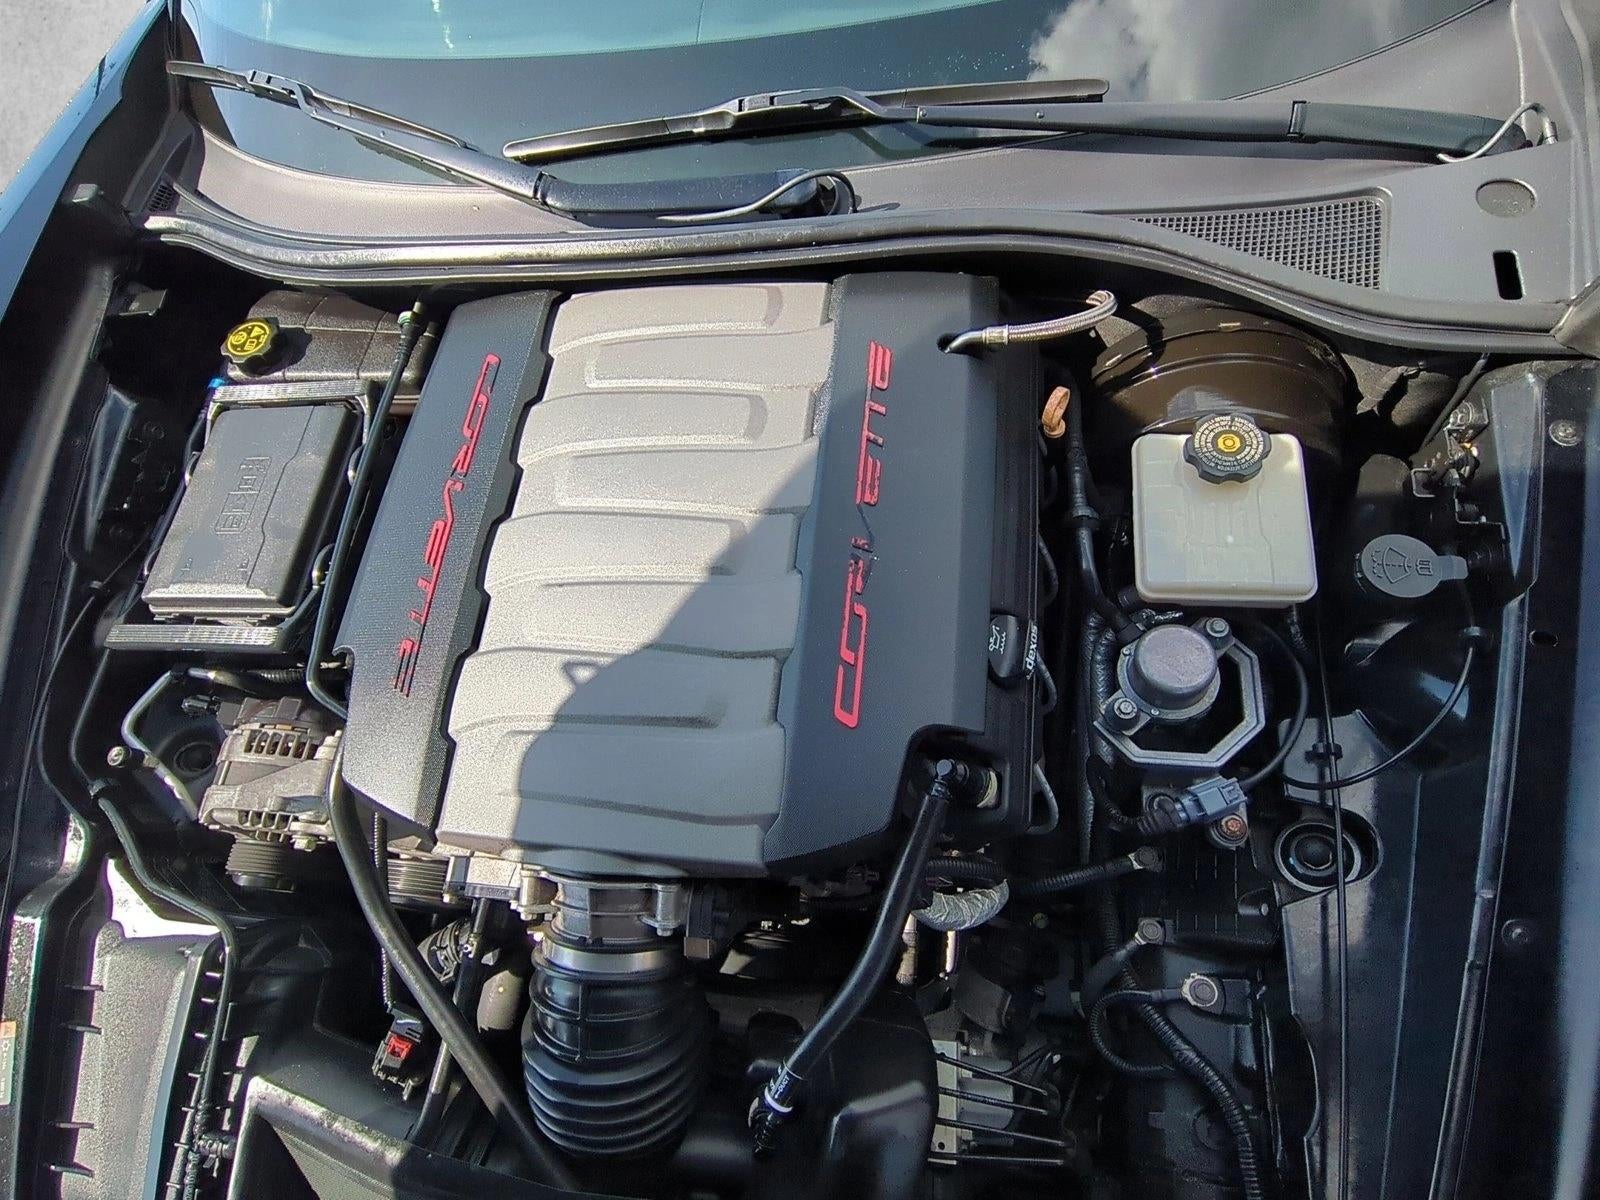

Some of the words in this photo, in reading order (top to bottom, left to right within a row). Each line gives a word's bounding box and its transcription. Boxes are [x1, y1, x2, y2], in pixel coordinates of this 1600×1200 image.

[396, 353, 501, 696] CORVETTE
[833, 341, 893, 729] CORVETTE
[1026, 624, 1038, 670] dexos
